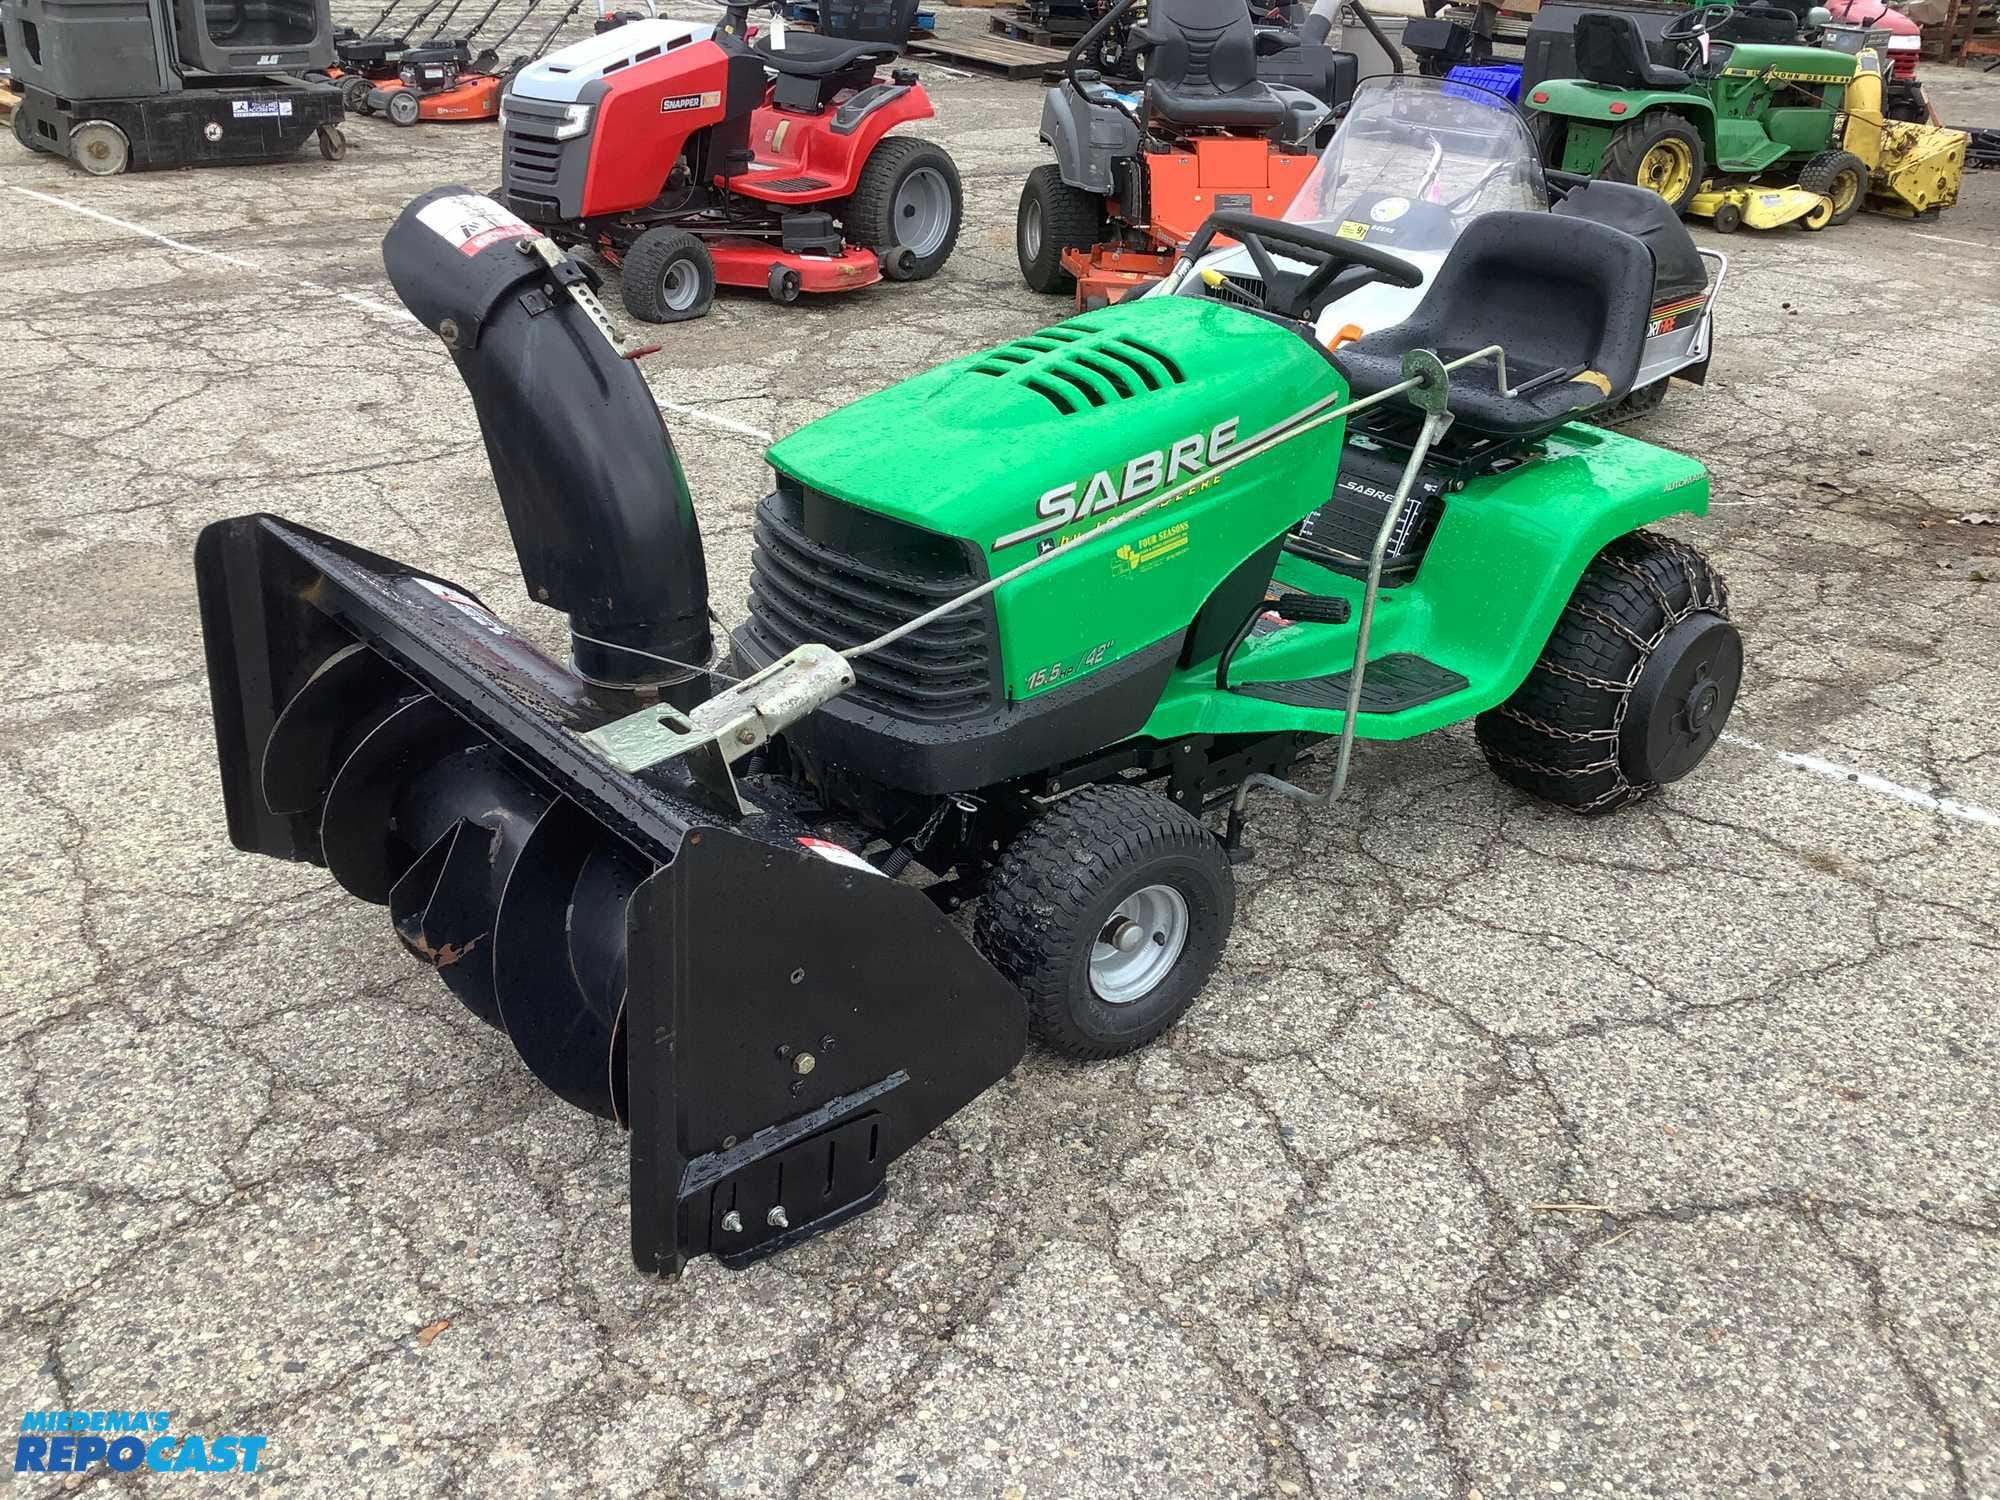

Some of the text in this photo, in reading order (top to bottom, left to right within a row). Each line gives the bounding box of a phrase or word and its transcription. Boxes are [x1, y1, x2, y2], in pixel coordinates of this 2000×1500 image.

[257, 55, 279, 65] JLG
[663, 97, 700, 110] SNAPPER
[1036, 415, 1240, 530] SABRE
[1344, 481, 1395, 503] SABRE
[1139, 534, 1157, 550] FOUR
[1158, 520, 1190, 541] SEASONS
